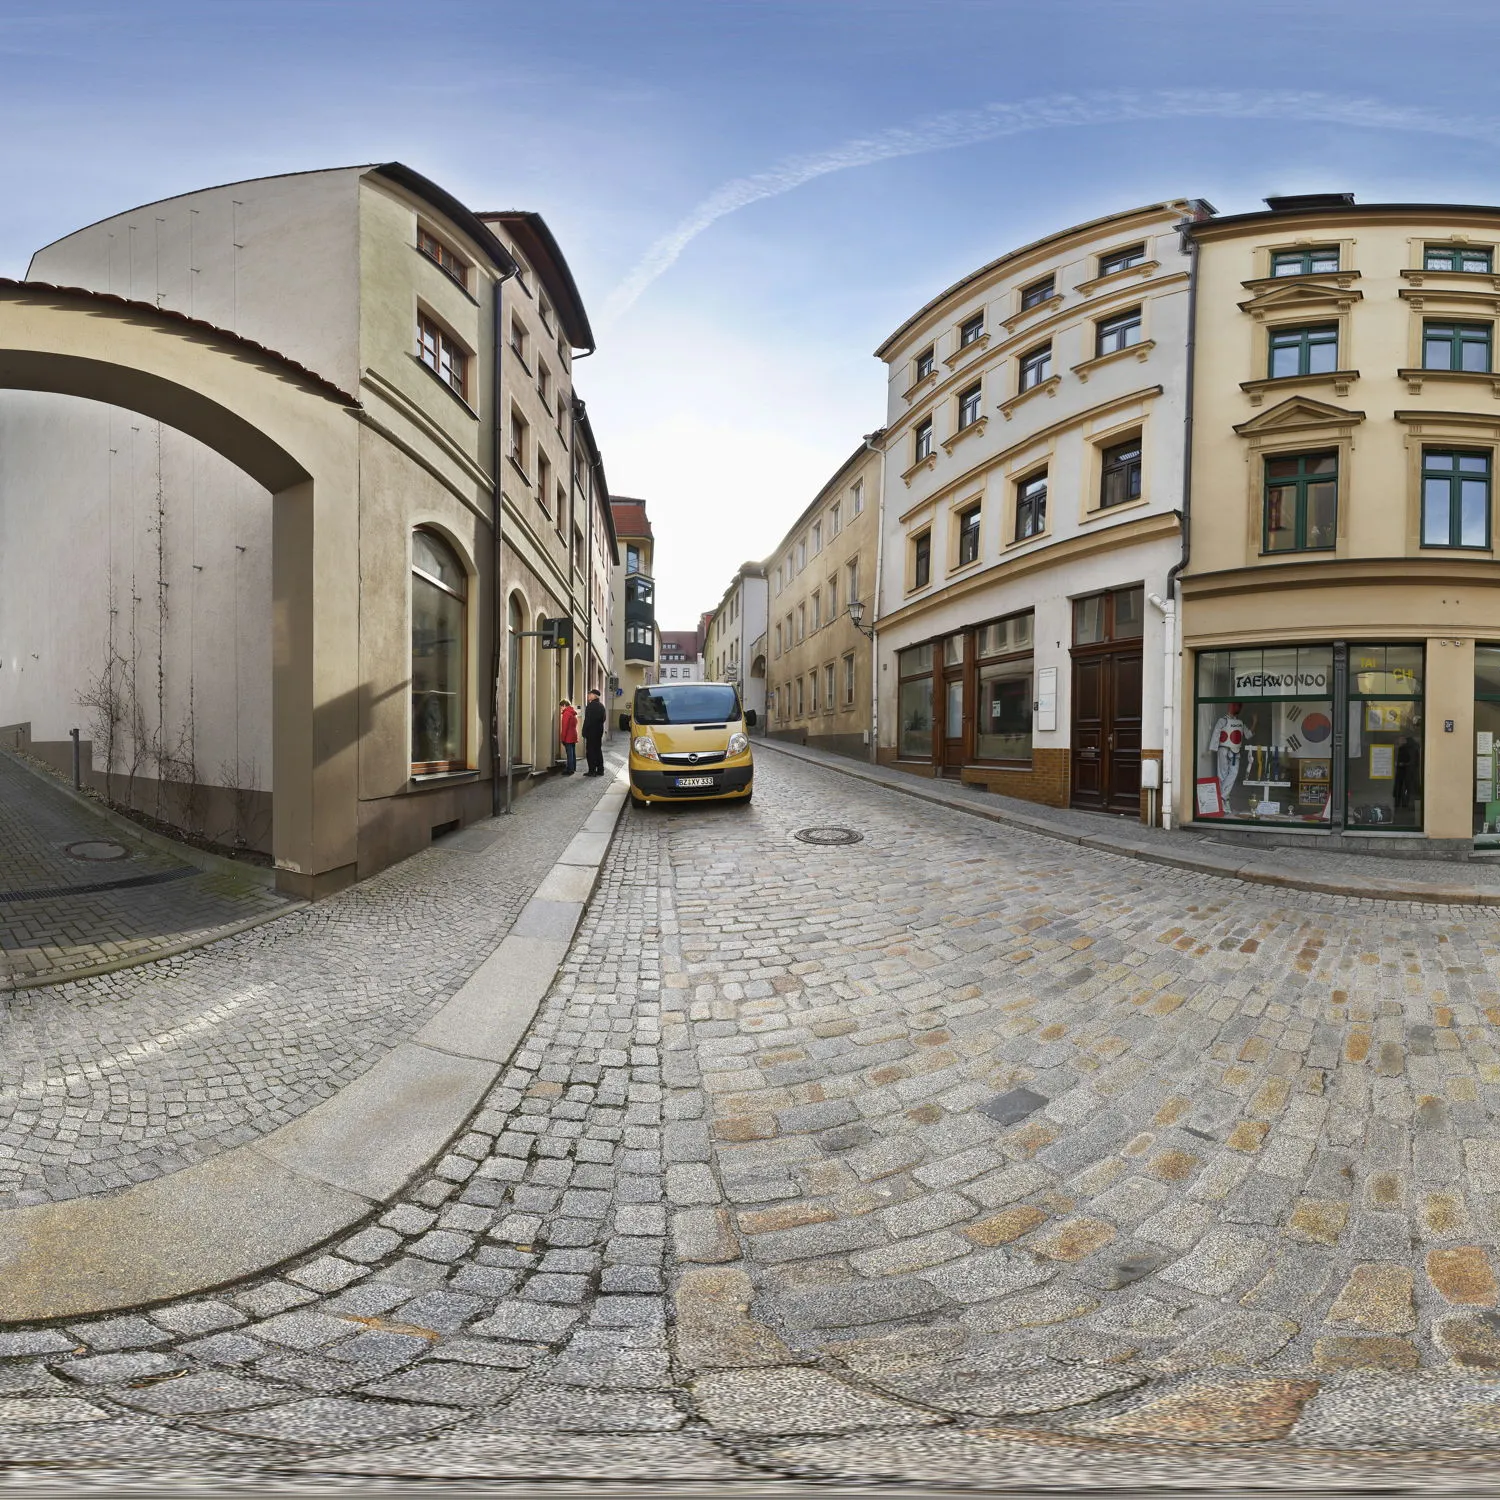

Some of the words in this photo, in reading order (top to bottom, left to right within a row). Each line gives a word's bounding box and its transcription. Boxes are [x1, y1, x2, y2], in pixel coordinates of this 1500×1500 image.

[1360, 657, 1376, 668] TAI
[1392, 667, 1414, 679] CHI
[1236, 674, 1326, 688] TAEKWONDO
[701, 777, 712, 785] 333
